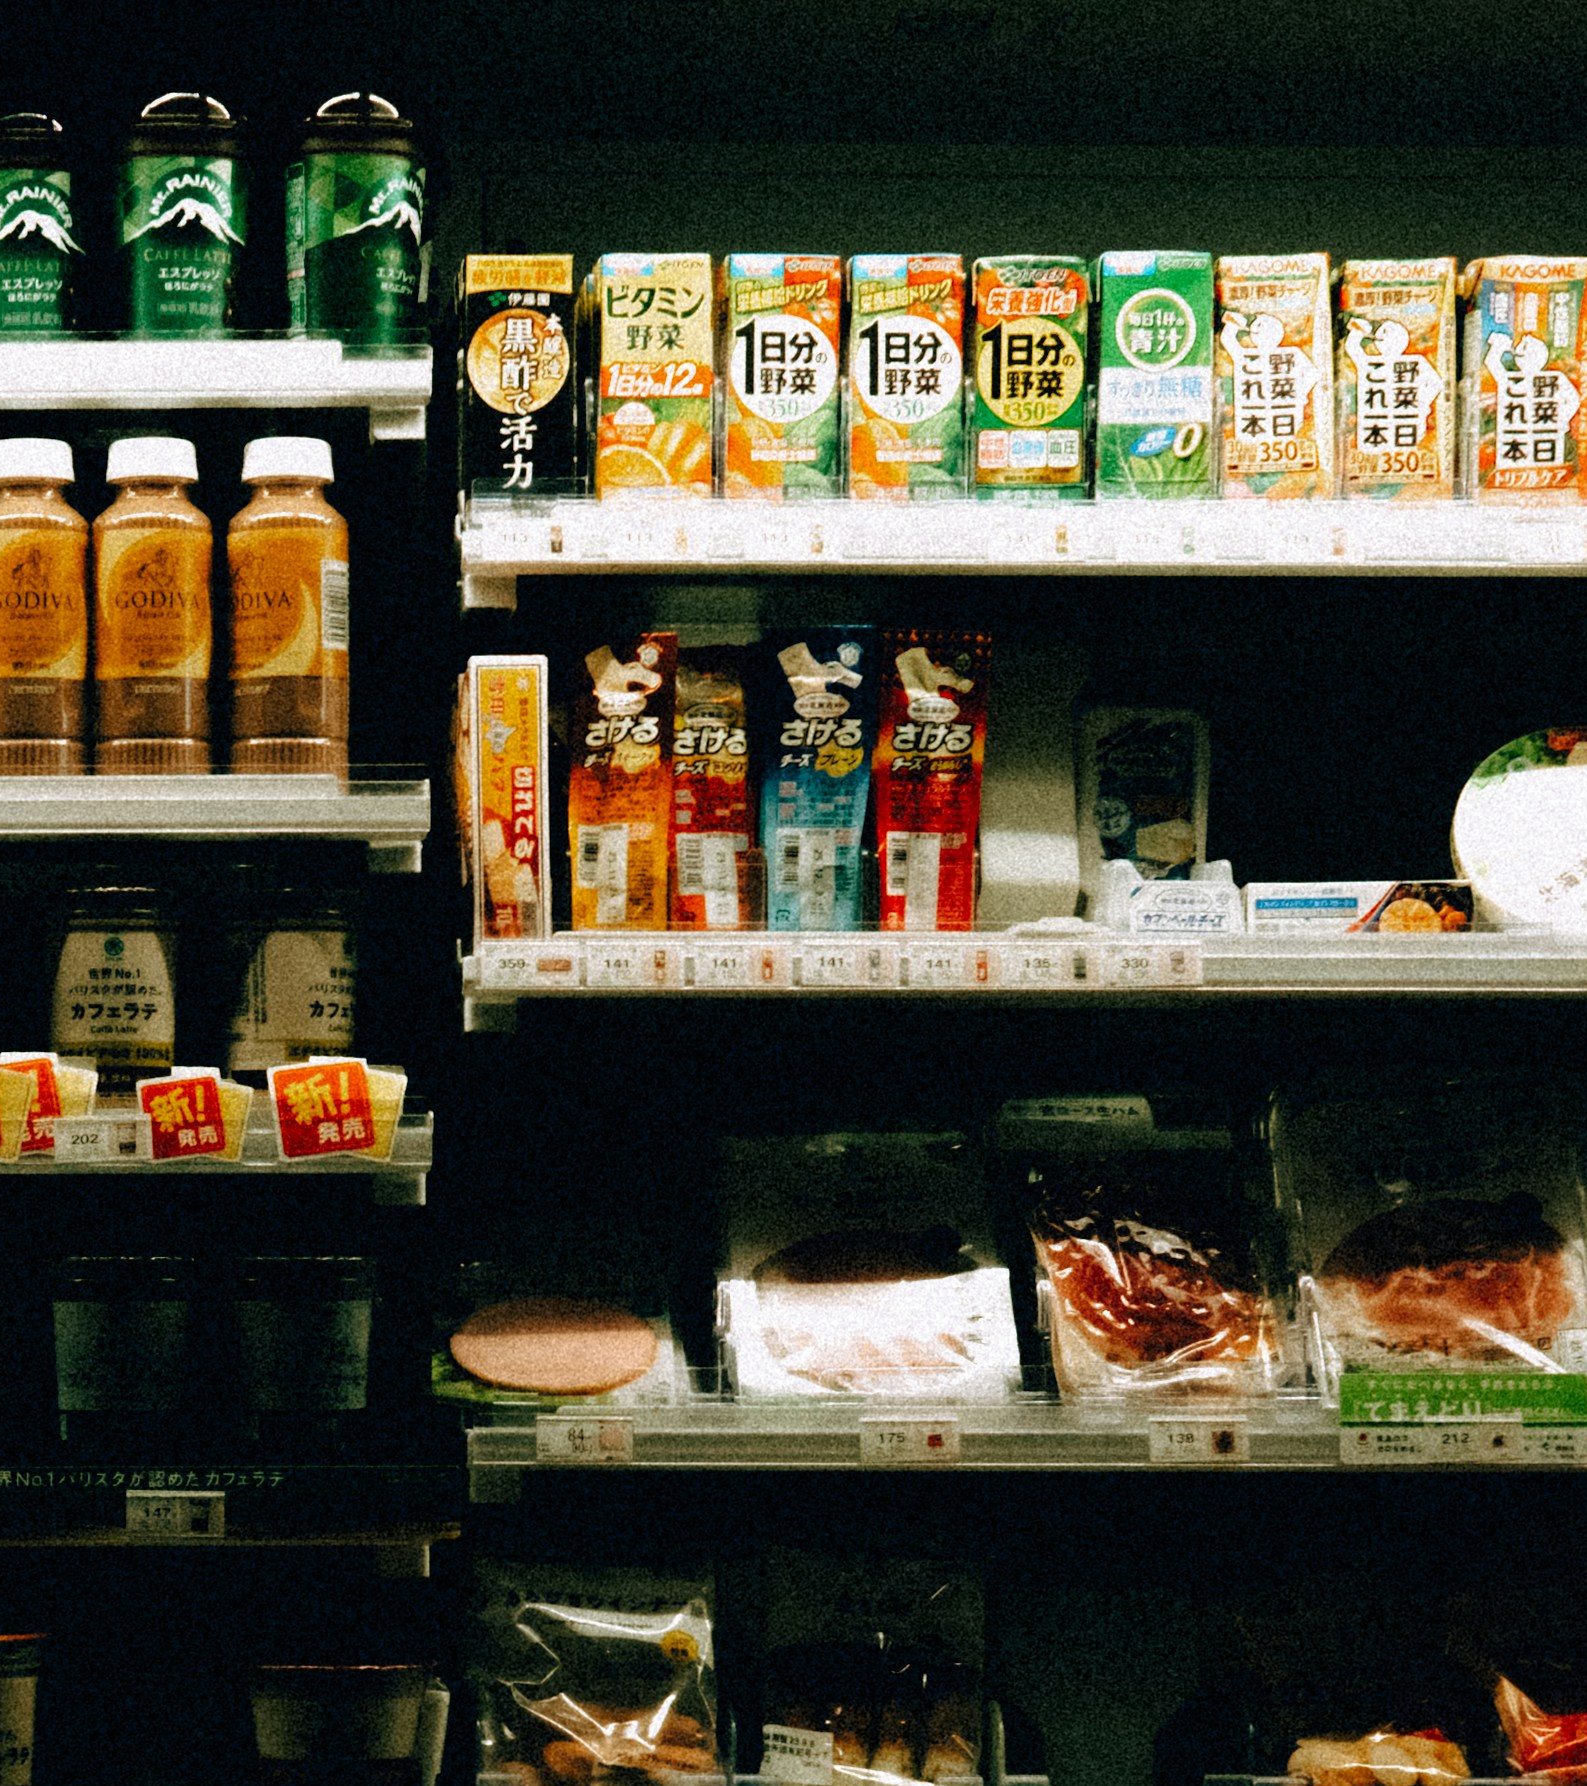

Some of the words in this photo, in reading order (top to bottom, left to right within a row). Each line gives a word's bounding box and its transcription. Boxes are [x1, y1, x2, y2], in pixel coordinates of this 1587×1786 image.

[1232, 259, 1308, 275] KAGOME
[1360, 263, 1436, 280] KAGOME
[1500, 263, 1577, 280] KAGOME
[606, 285, 705, 320] ビタミン
[626, 325, 685, 351] 野菜
[1131, 329, 1182, 354] 青汁
[760, 368, 817, 395] 野菜
[885, 370, 942, 396] 野菜
[1007, 372, 1065, 400] 野菜
[500, 318, 540, 489] 黒酢で活力
[1241, 355, 1264, 438] これ一本
[1269, 354, 1297, 438] 野菜一日
[1363, 361, 1389, 448] これ一本
[1392, 361, 1420, 447] 野菜一日
[1502, 377, 1529, 464] これ一本
[1532, 376, 1560, 464] 野菜一日
[1260, 440, 1299, 462] 350
[1381, 452, 1420, 473] 350
[115, 592, 198, 610] GODIVA
[585, 716, 660, 748] さける
[673, 727, 746, 756] さける
[780, 717, 863, 748] さける
[892, 722, 973, 754] さける
[71, 1002, 158, 1021] カフェラテ
[151, 1085, 205, 1132] 新!
[285, 1072, 351, 1127] 新!
[177, 1127, 218, 1148] 発売
[317, 1120, 365, 1144] 発売
